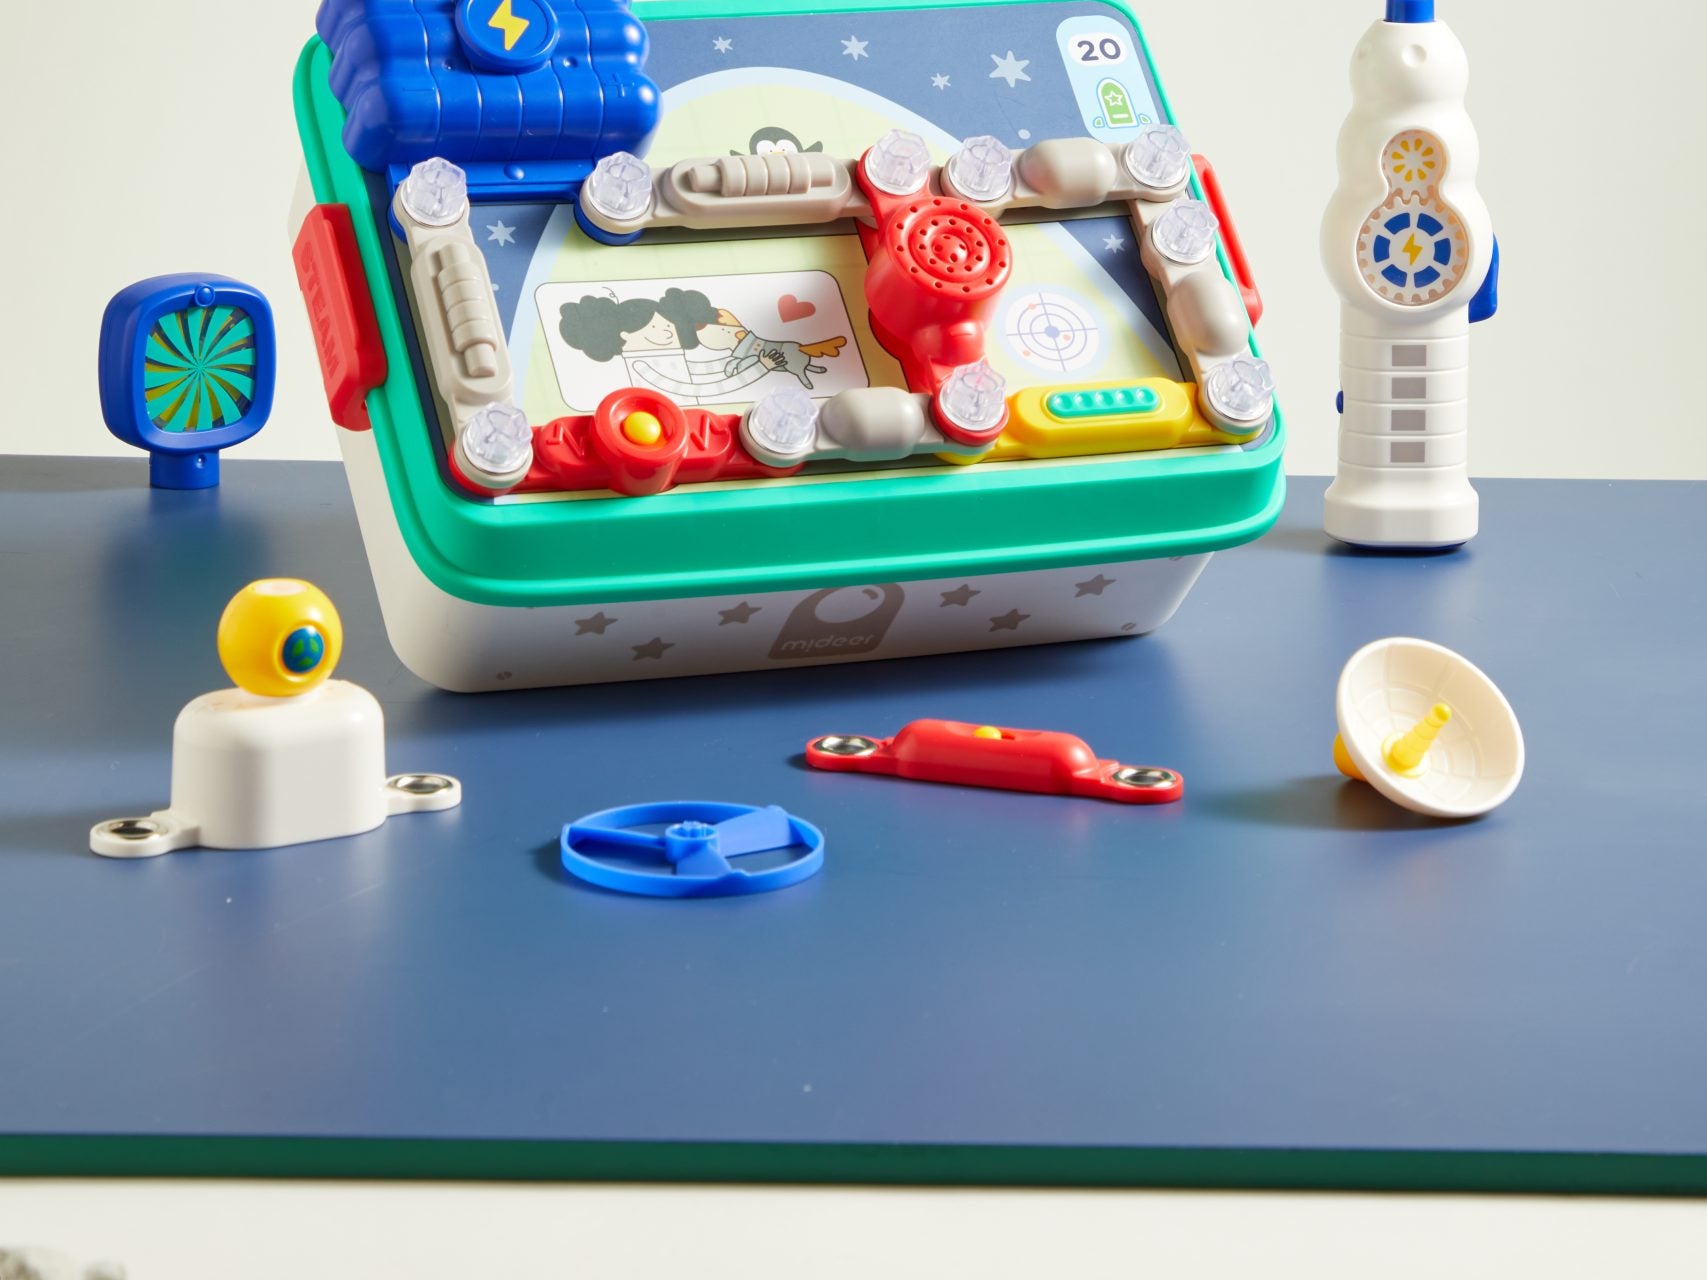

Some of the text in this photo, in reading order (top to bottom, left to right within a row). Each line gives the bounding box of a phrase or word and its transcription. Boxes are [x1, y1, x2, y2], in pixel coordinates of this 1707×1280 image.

[1077, 38, 1121, 61] 20
[301, 241, 339, 377] STEAM
[781, 633, 875, 652] mideer
